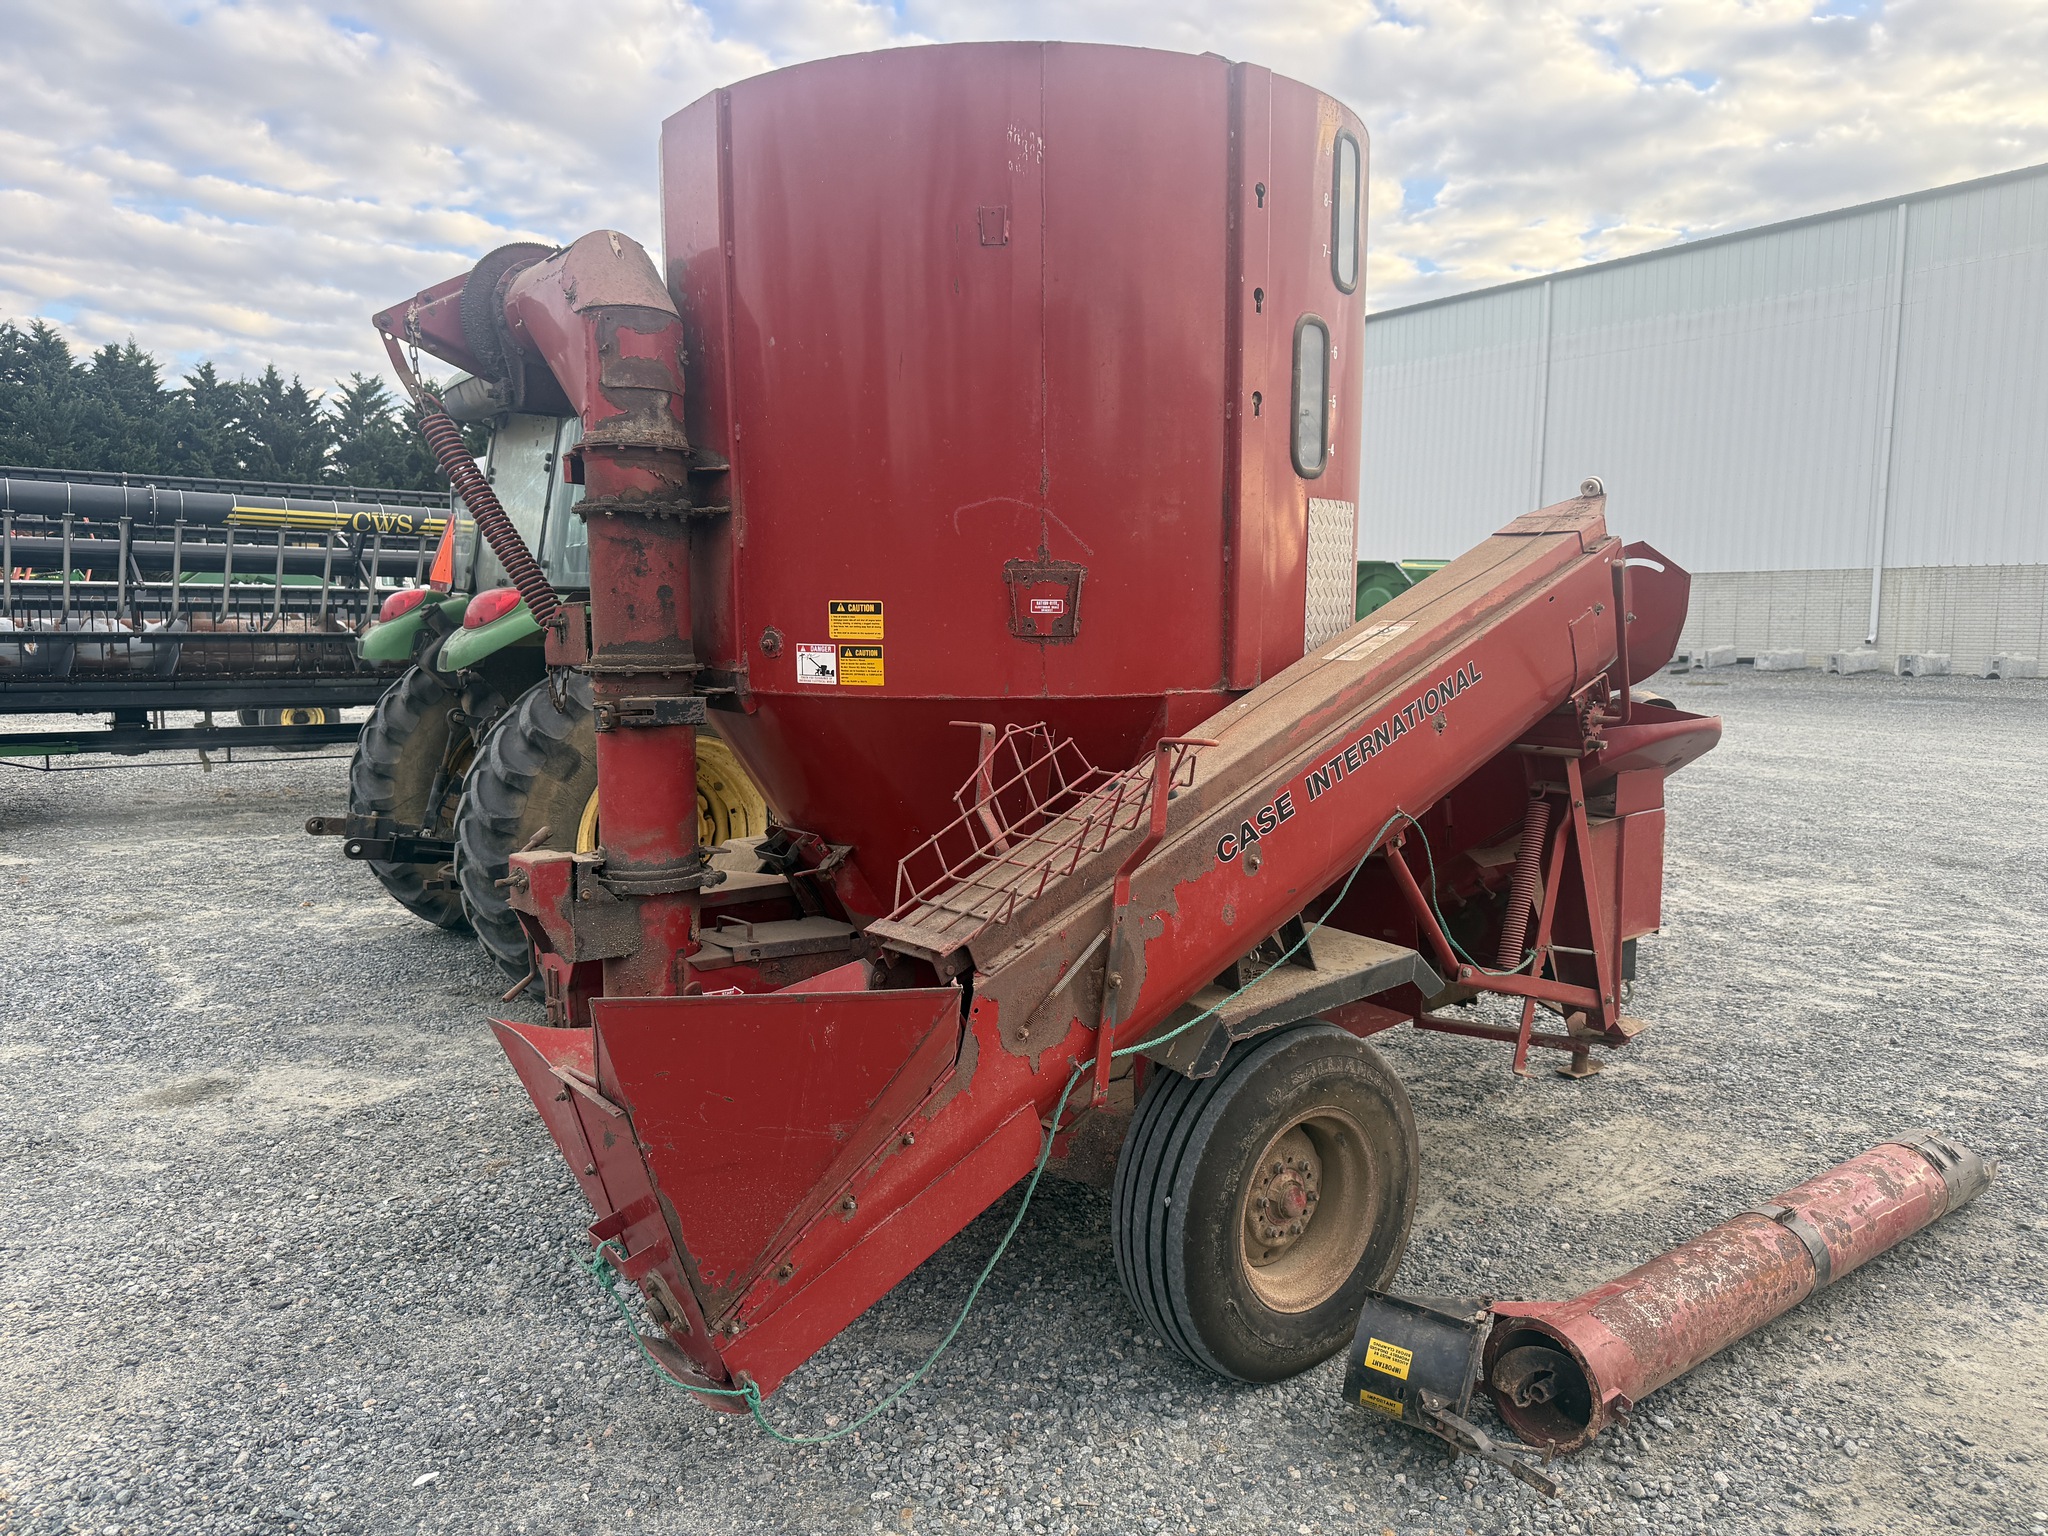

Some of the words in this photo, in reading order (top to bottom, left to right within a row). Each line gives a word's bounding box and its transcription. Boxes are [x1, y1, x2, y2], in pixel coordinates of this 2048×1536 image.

[1323, 192, 1329, 207] 8
[352, 511, 413, 534] CWS
[847, 603, 875, 612] CAUTION
[810, 645, 832, 653] DANGER
[855, 649, 878, 657] CAUTION
[1216, 790, 1296, 863] CASE
[1304, 660, 1483, 802] INTERNATIONAL
[1371, 1359, 1402, 1374] IMPORTANT
[1366, 1394, 1396, 1408] IMPORTANT
